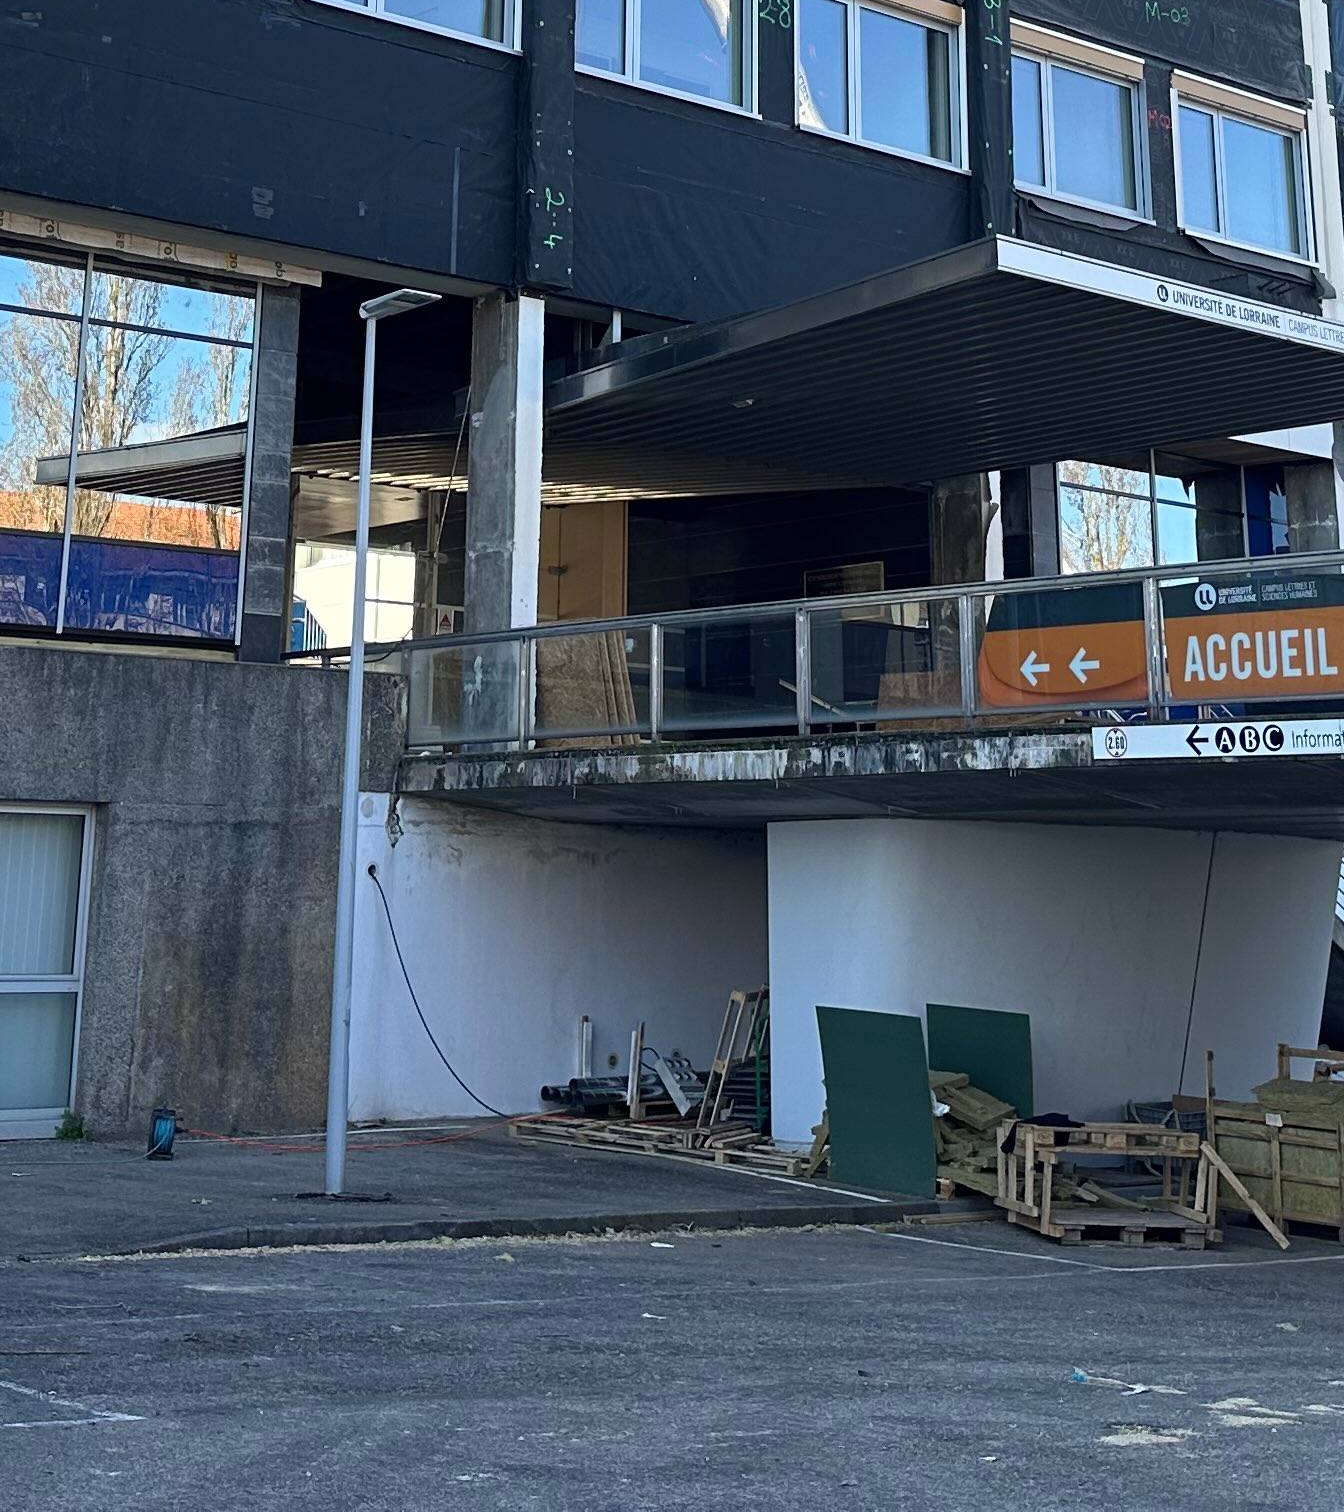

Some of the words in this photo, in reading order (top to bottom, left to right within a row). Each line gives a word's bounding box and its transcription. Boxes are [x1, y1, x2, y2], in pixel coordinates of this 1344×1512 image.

[1173, 290, 1223, 315] UNIVERSITÉ
[1226, 304, 1237, 318] DE
[1239, 307, 1280, 328] LORRAINE
[1289, 319, 1319, 337] CAMPUS
[1184, 628, 1338, 683] ACCUEIL
